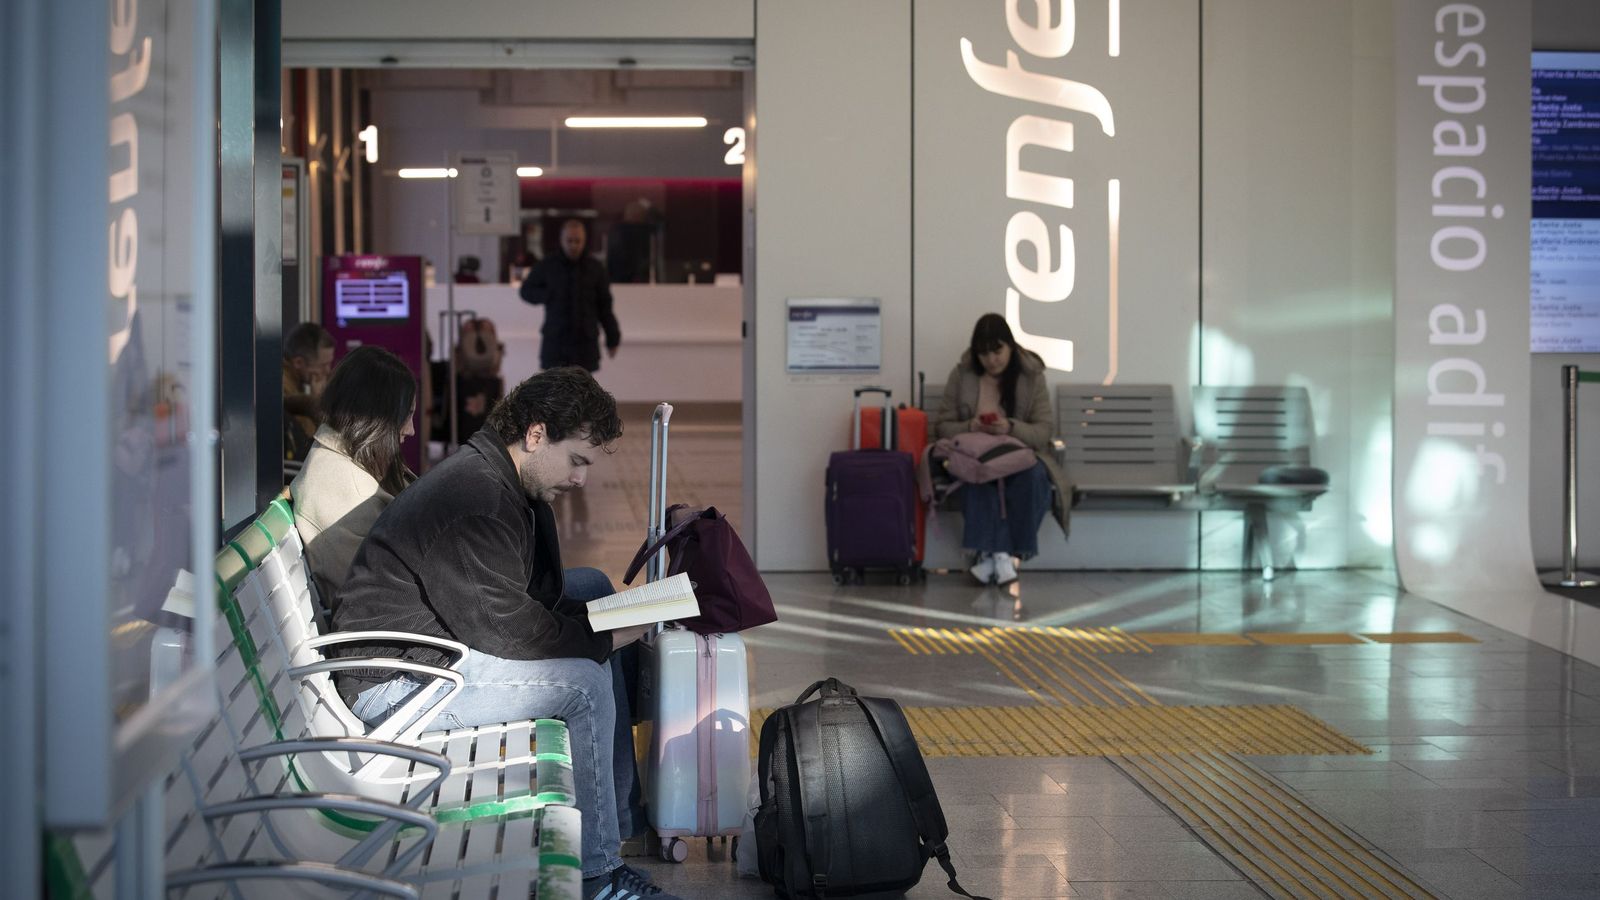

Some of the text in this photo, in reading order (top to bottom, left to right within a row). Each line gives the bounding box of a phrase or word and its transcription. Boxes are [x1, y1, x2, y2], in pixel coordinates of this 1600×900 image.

[359, 125, 378, 163] 1
[723, 127, 745, 165] 2
[960, 0, 1115, 372] renfe
[1417, 3, 1505, 272] espacio
